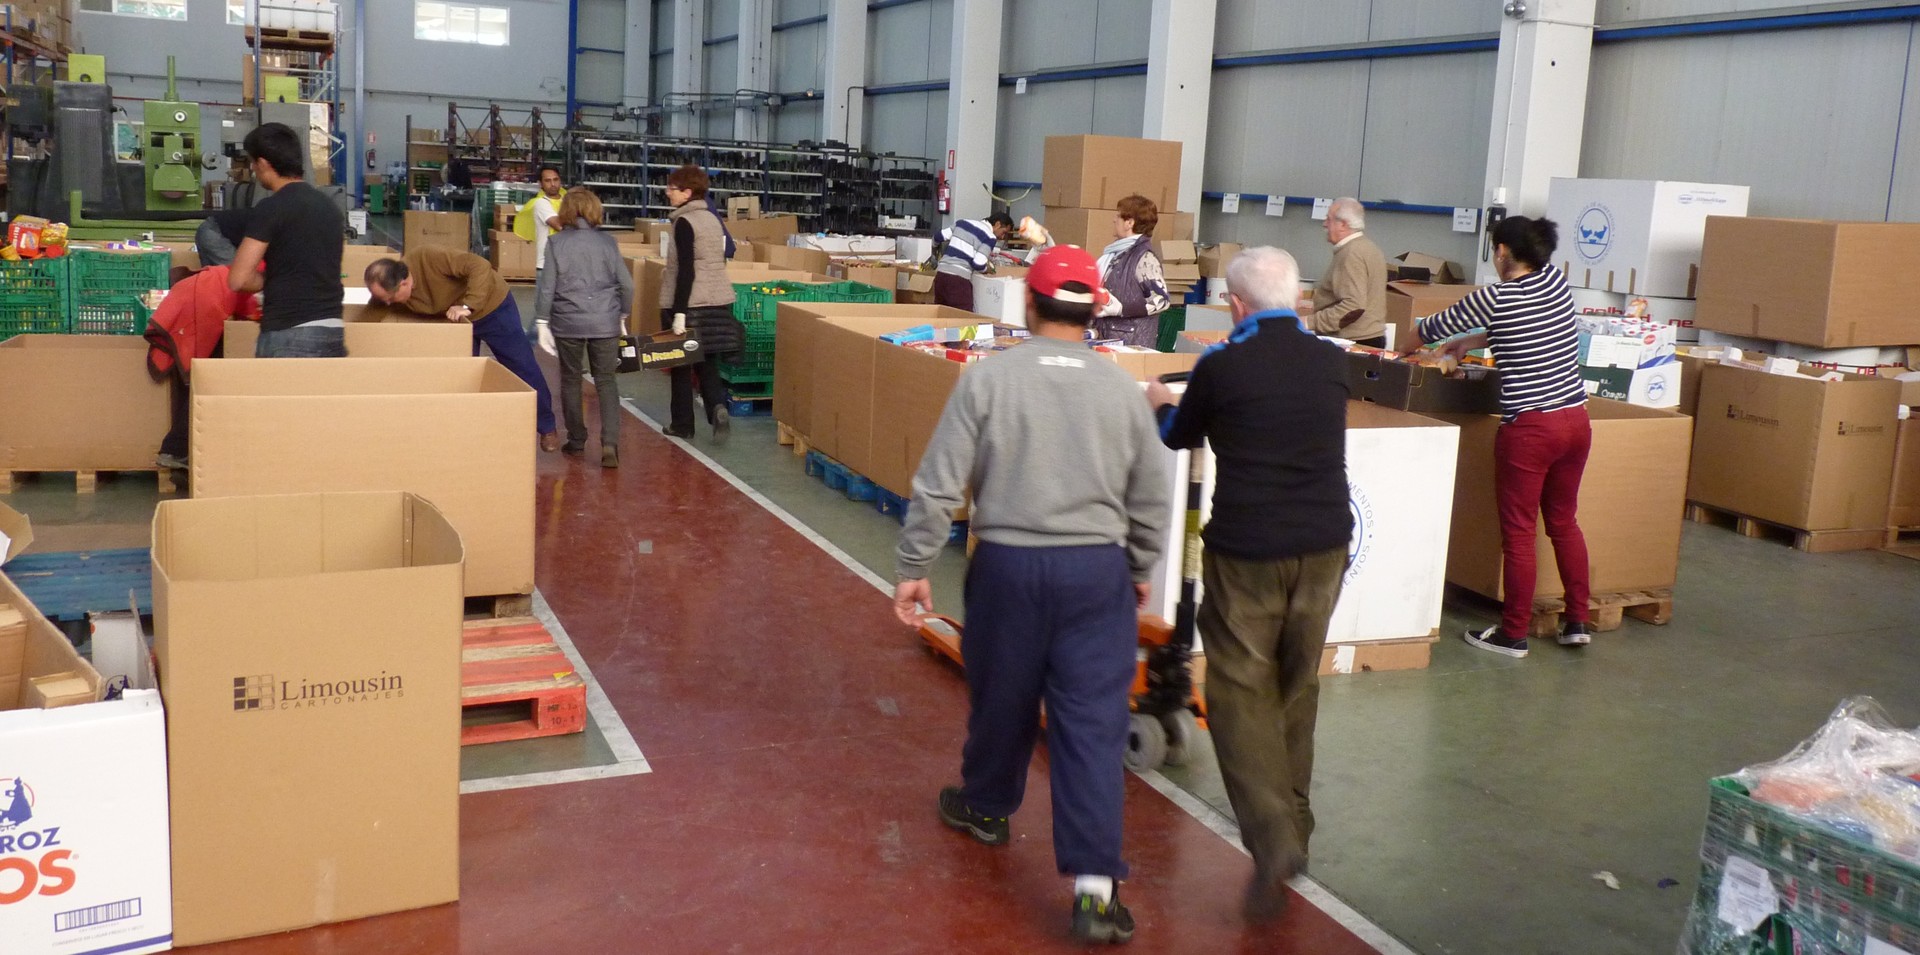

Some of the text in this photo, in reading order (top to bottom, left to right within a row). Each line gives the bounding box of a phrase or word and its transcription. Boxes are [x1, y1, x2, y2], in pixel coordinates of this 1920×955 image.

[1740, 409, 1779, 426] Limousin
[281, 670, 403, 701] Limousin
[281, 690, 404, 710] CARTONAJES
[0, 849, 76, 905] OS
